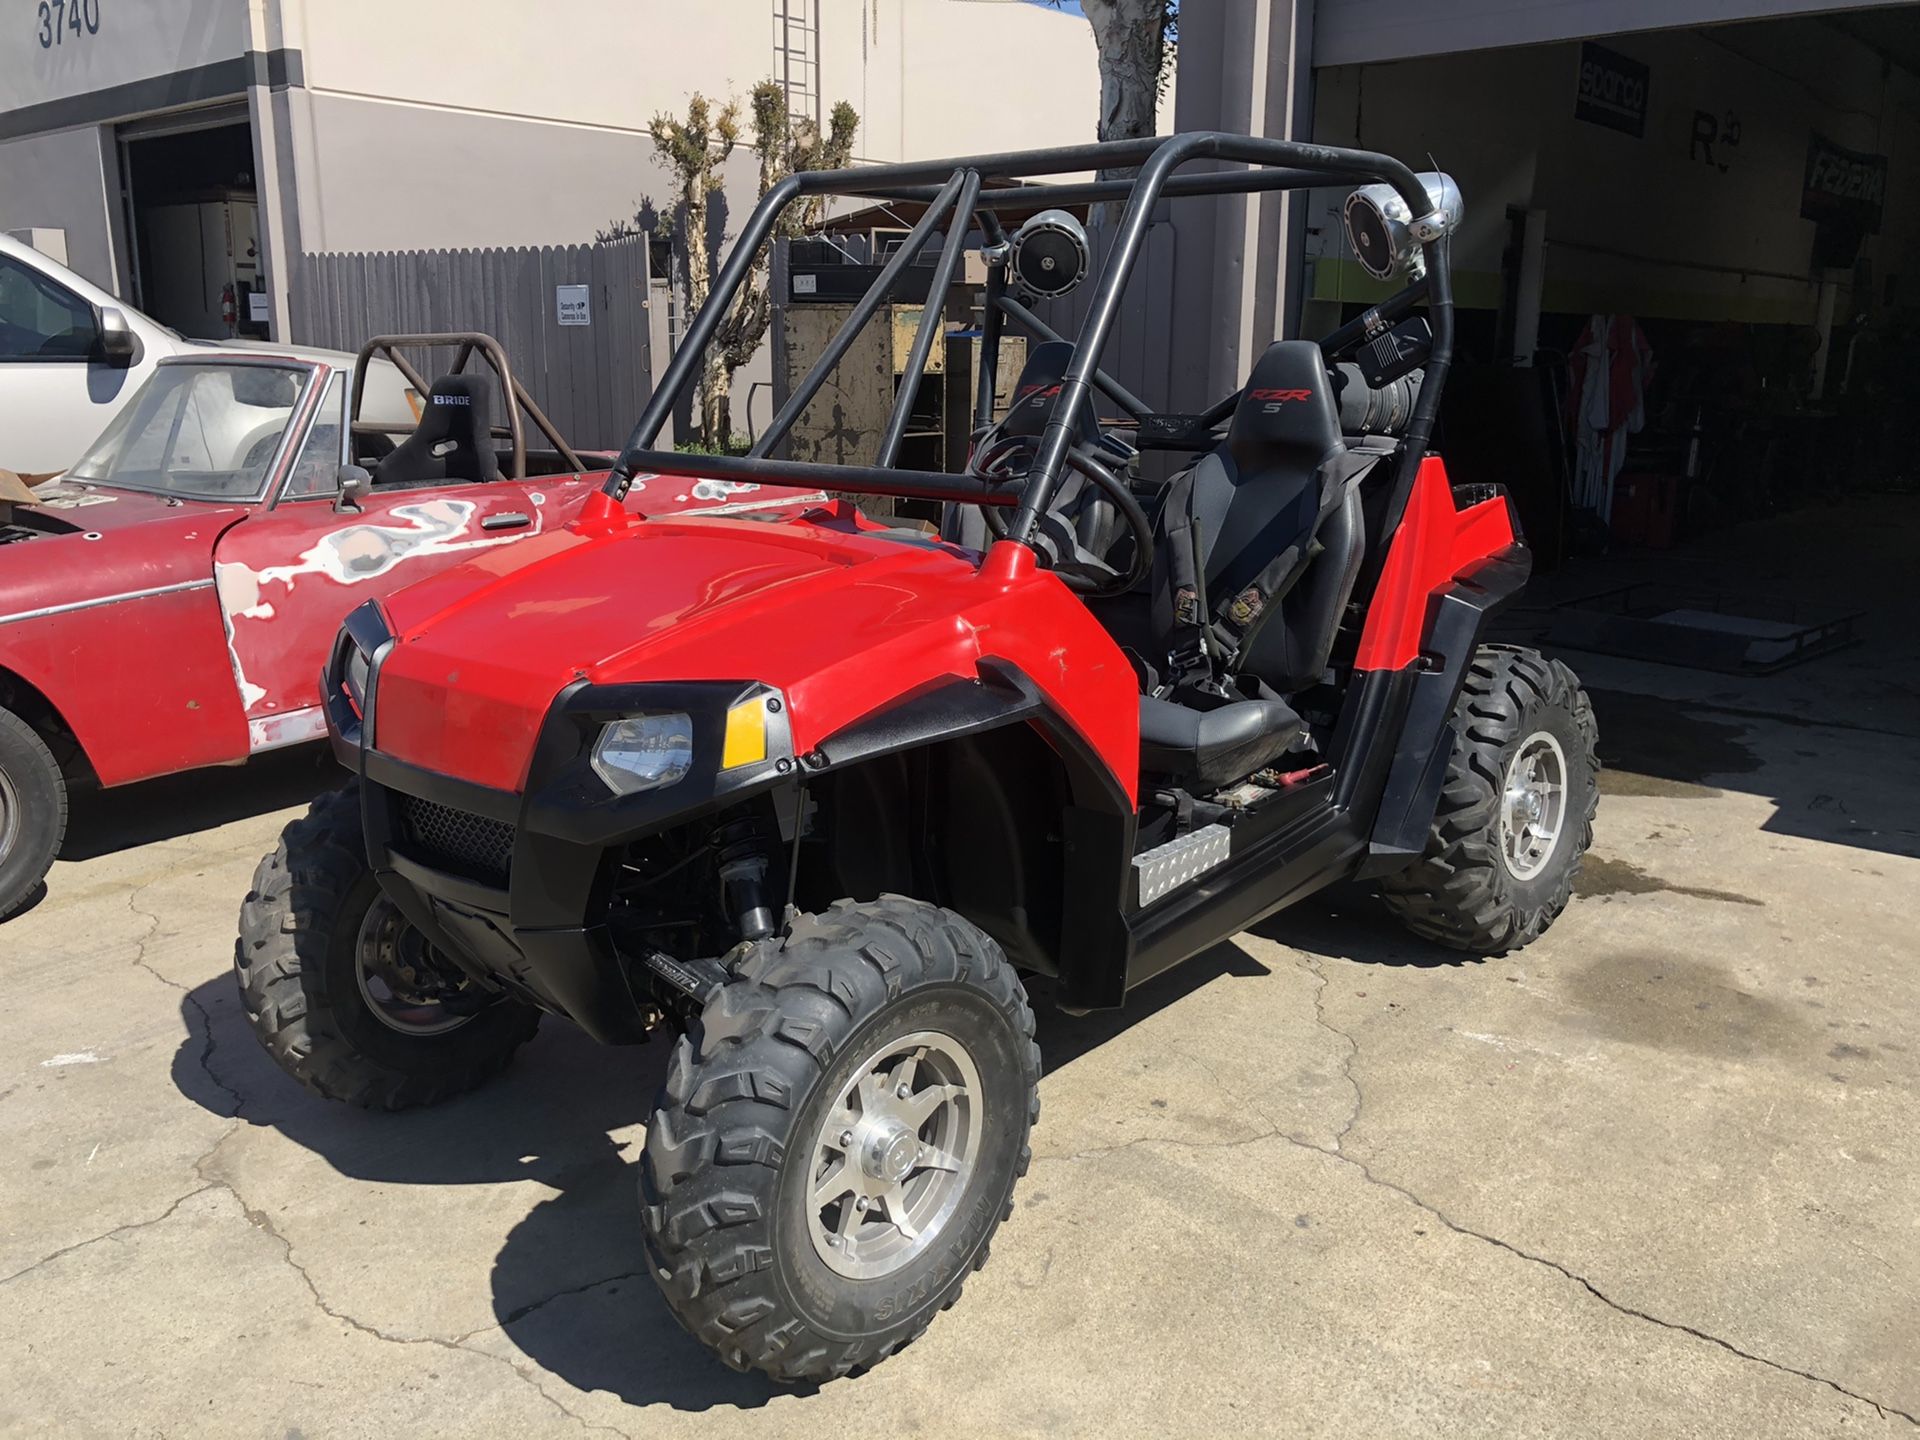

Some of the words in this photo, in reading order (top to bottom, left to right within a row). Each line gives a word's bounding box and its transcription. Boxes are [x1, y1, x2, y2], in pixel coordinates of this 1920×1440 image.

[38, 0, 100, 49] 3740
[1582, 60, 1643, 110] sparco
[1809, 150, 1883, 206] FEDERA
[432, 394, 471, 406] BRIDE
[1029, 397, 1047, 408] S
[1247, 387, 1313, 402] RZR
[1261, 402, 1283, 414] S
[873, 1194, 992, 1321] MAXXIS
